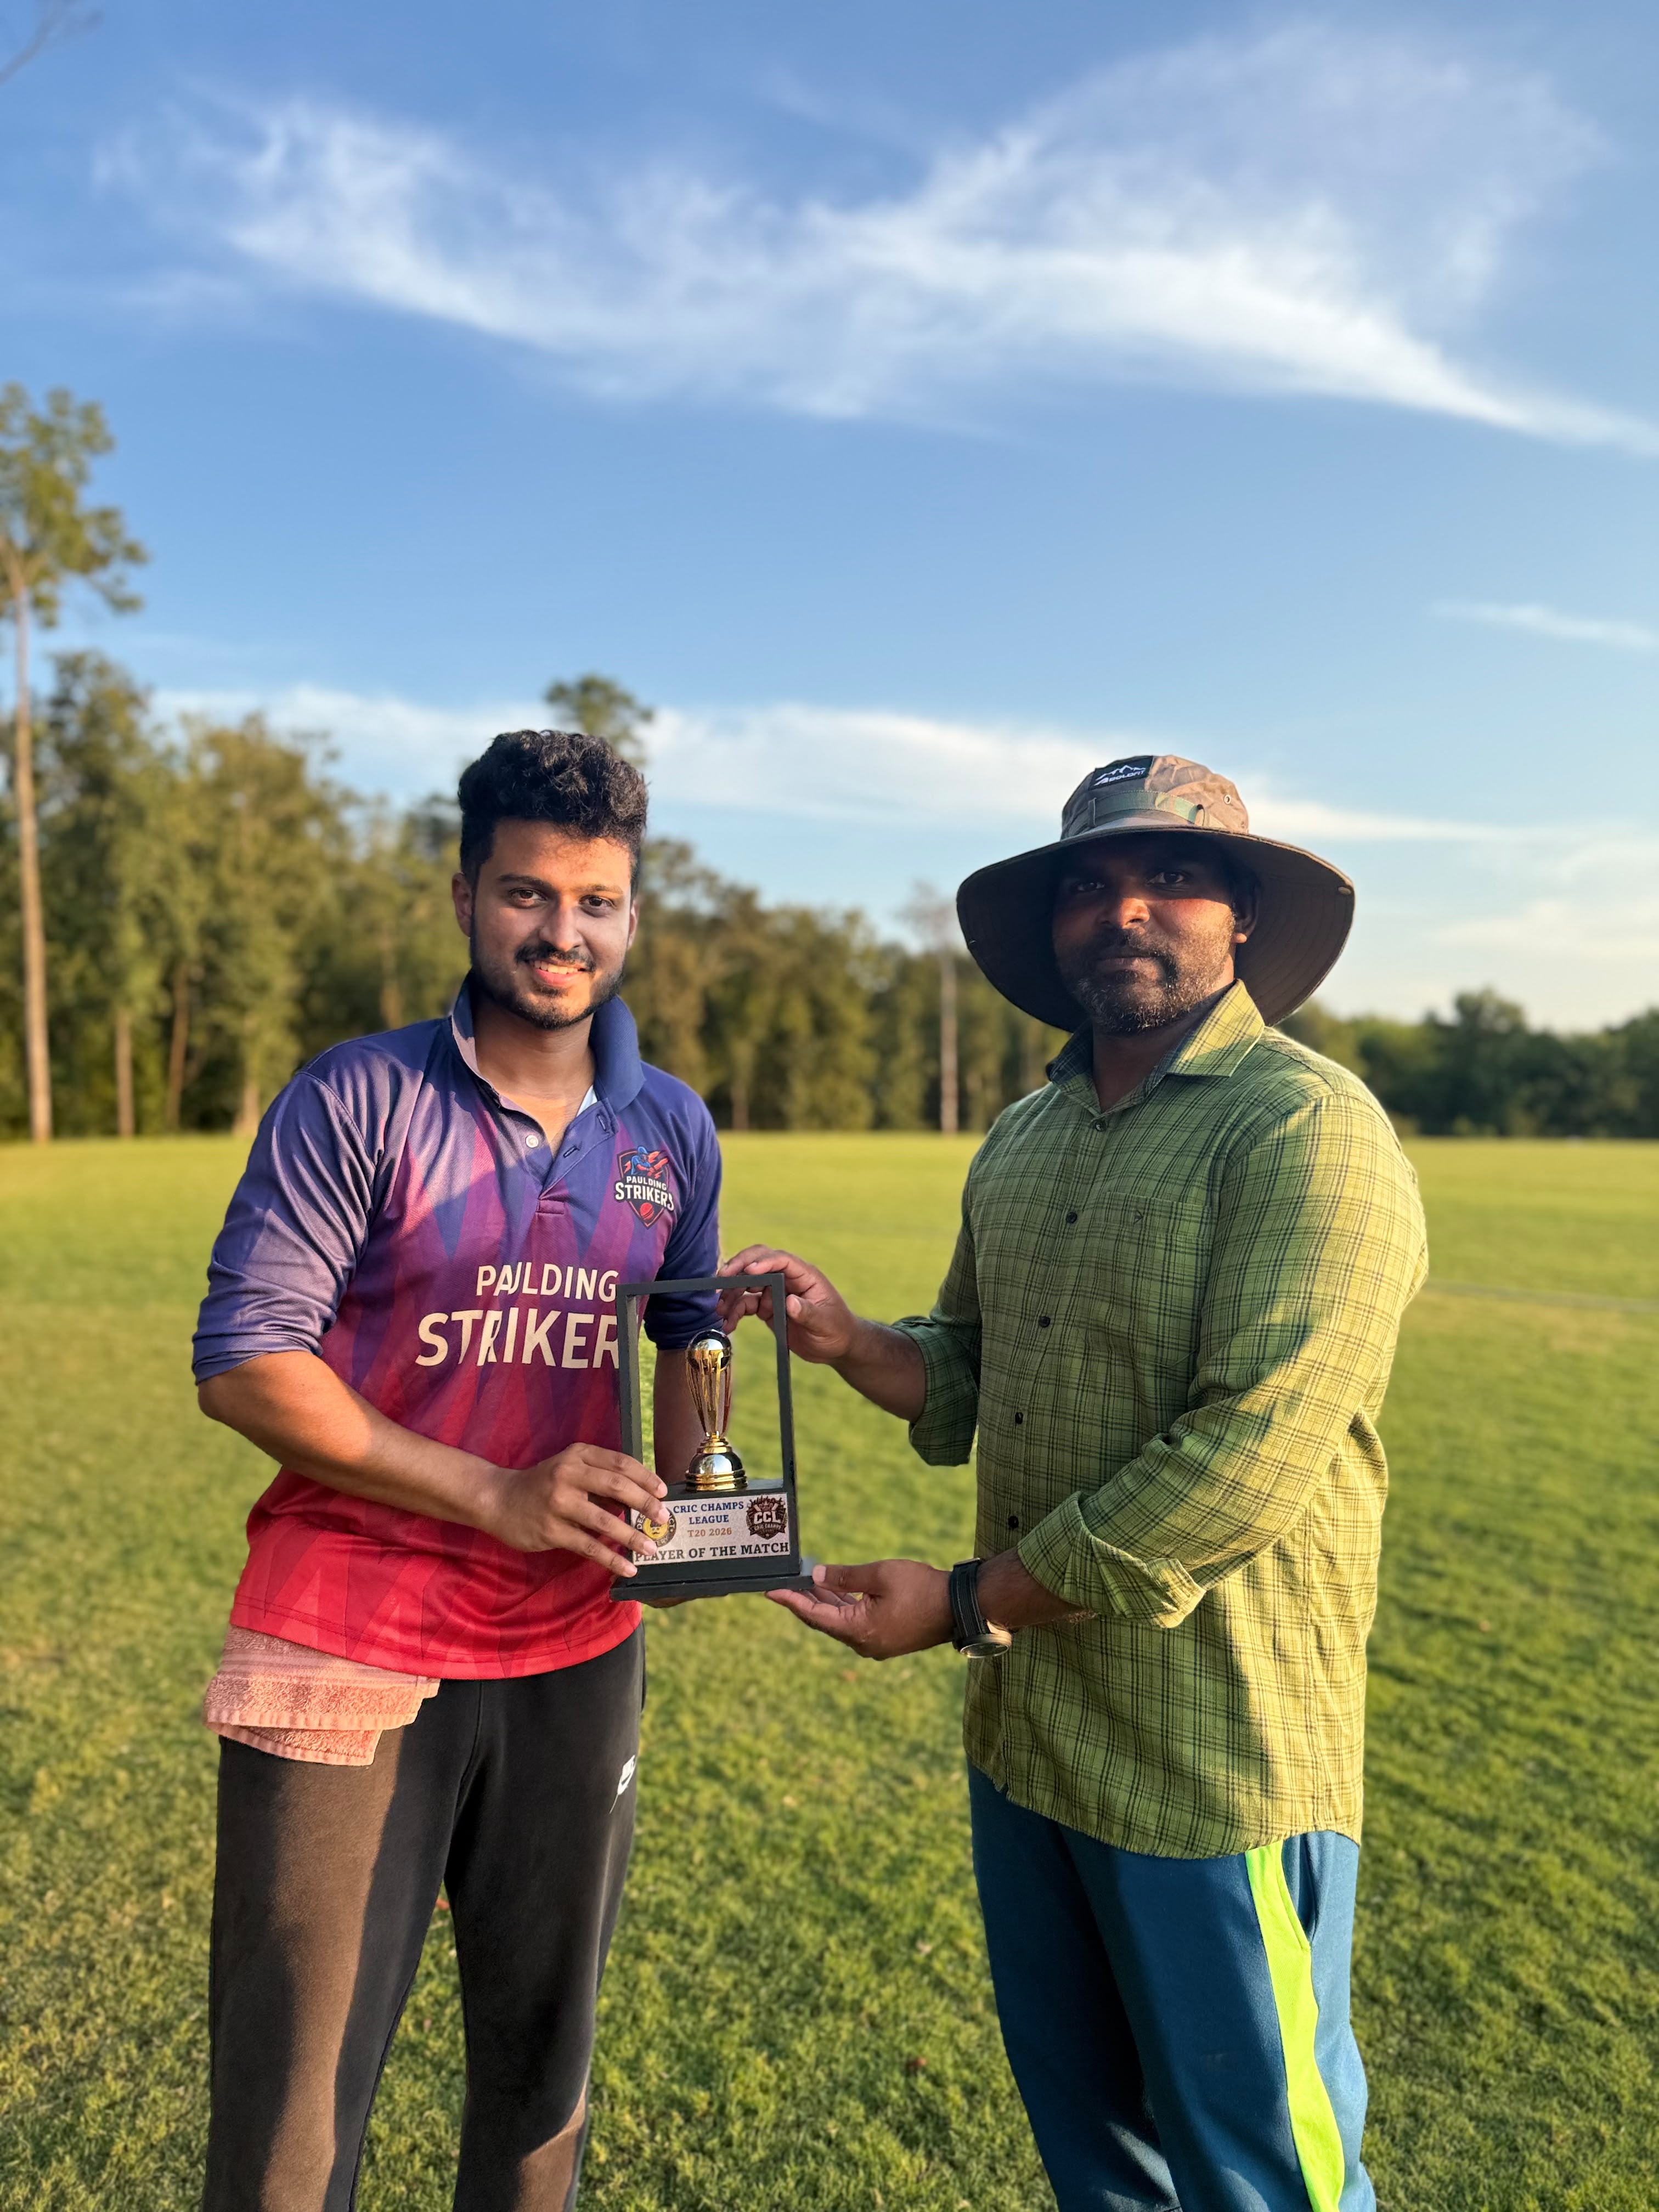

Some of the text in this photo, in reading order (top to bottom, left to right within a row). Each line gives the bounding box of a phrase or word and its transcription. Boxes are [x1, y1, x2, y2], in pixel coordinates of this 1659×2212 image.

[1108, 770, 1146, 782] BOLDFIT
[626, 1176, 667, 1190] PAULDING
[615, 1182, 674, 1211] STRIKERS
[415, 1307, 619, 1369] STRIKER
[673, 1501, 744, 1514] CRIC CHAMPS
[689, 1514, 729, 1525] LEAGUE
[753, 1510, 781, 1525] CCL
[687, 1527, 732, 1537] T20 2026
[635, 1542, 789, 1562] PLAYER OF THE MATCH
